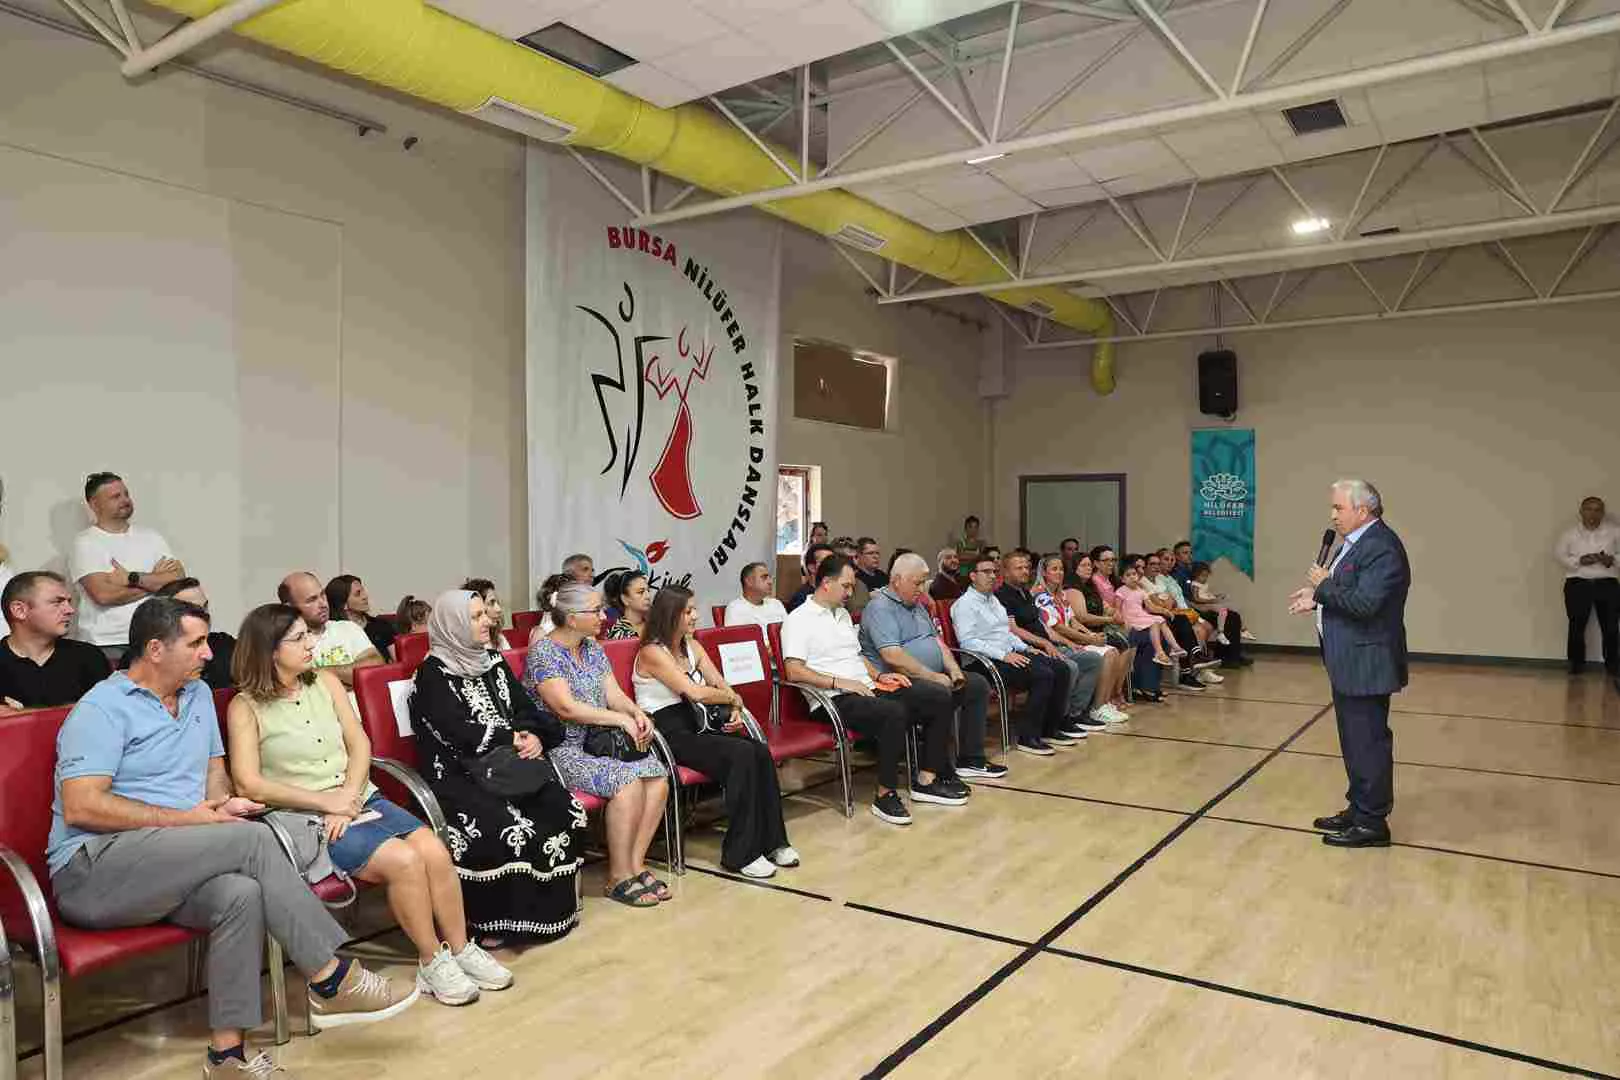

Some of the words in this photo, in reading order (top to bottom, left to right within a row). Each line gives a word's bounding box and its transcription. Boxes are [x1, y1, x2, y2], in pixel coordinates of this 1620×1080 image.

[608, 225, 677, 267] BURSA
[683, 258, 746, 354] NİLÜFER
[739, 361, 764, 435] HALK
[708, 446, 765, 575] DANSLARI
